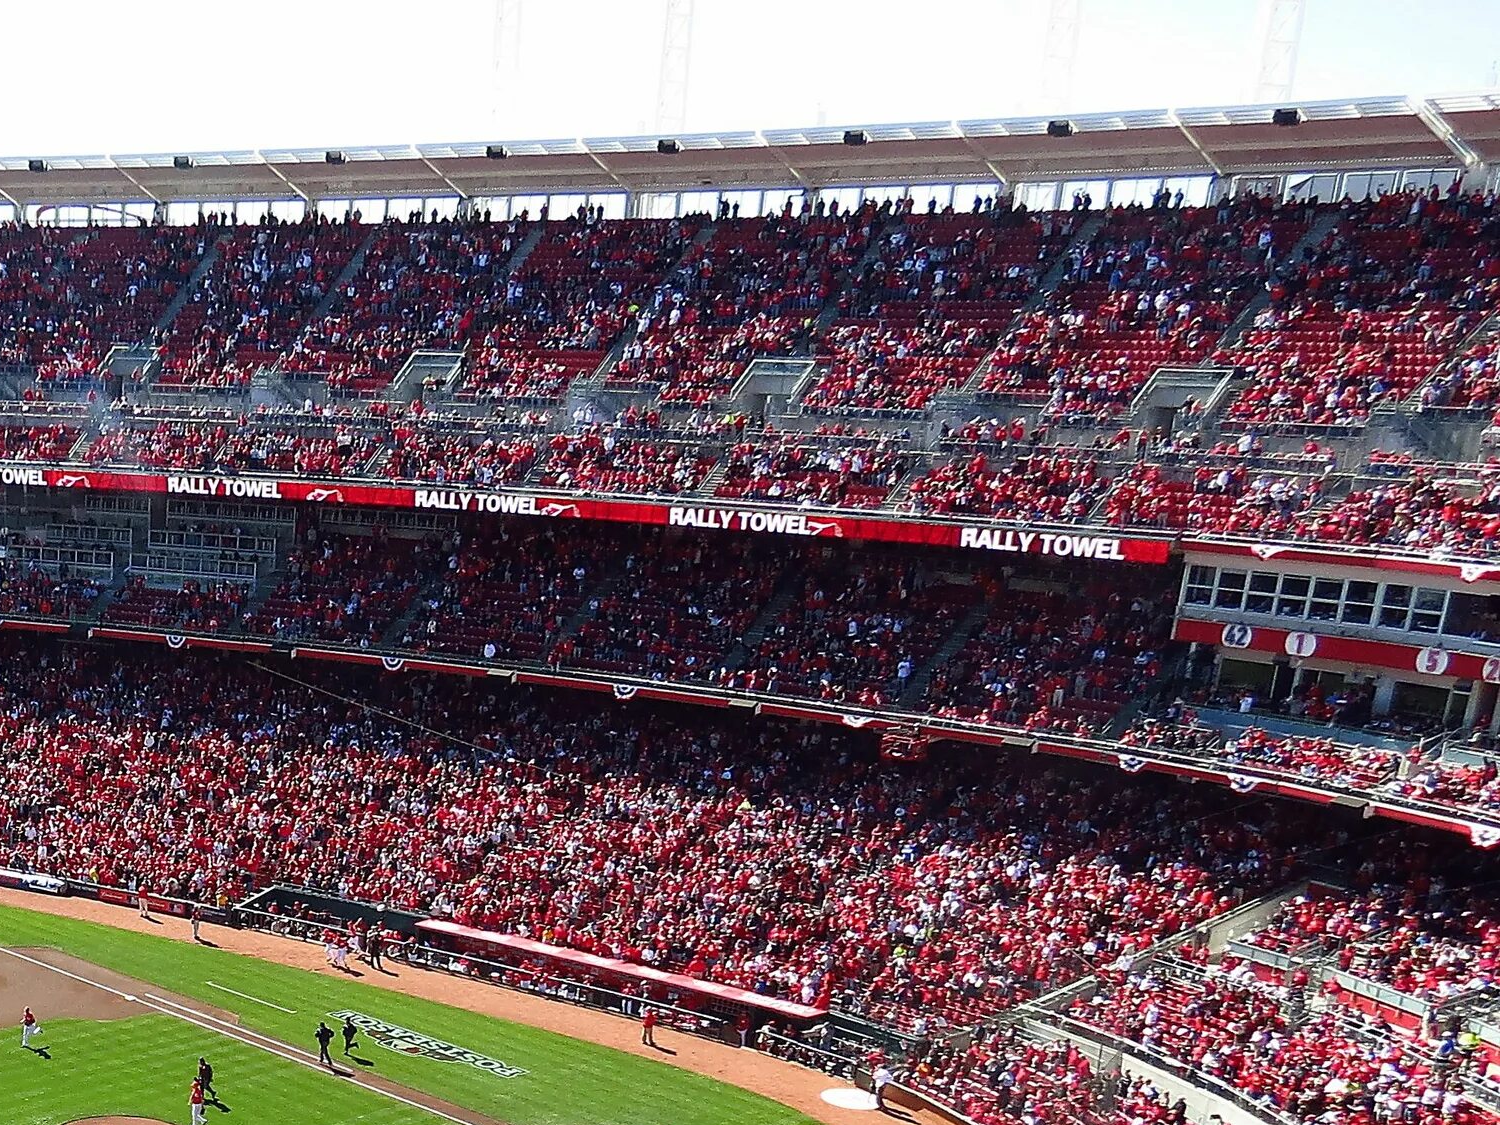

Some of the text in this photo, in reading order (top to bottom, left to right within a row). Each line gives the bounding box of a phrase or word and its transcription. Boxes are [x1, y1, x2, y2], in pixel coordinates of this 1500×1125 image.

[167, 476, 282, 499] RALLY TOWEL
[414, 490, 541, 516] RALLY TOWEL
[669, 507, 811, 535] RALLY TOWEL
[960, 527, 1125, 561] RALLY TOWEL
[1224, 624, 1248, 646] 42
[1294, 633, 1306, 653] 1
[1425, 650, 1440, 673] 5
